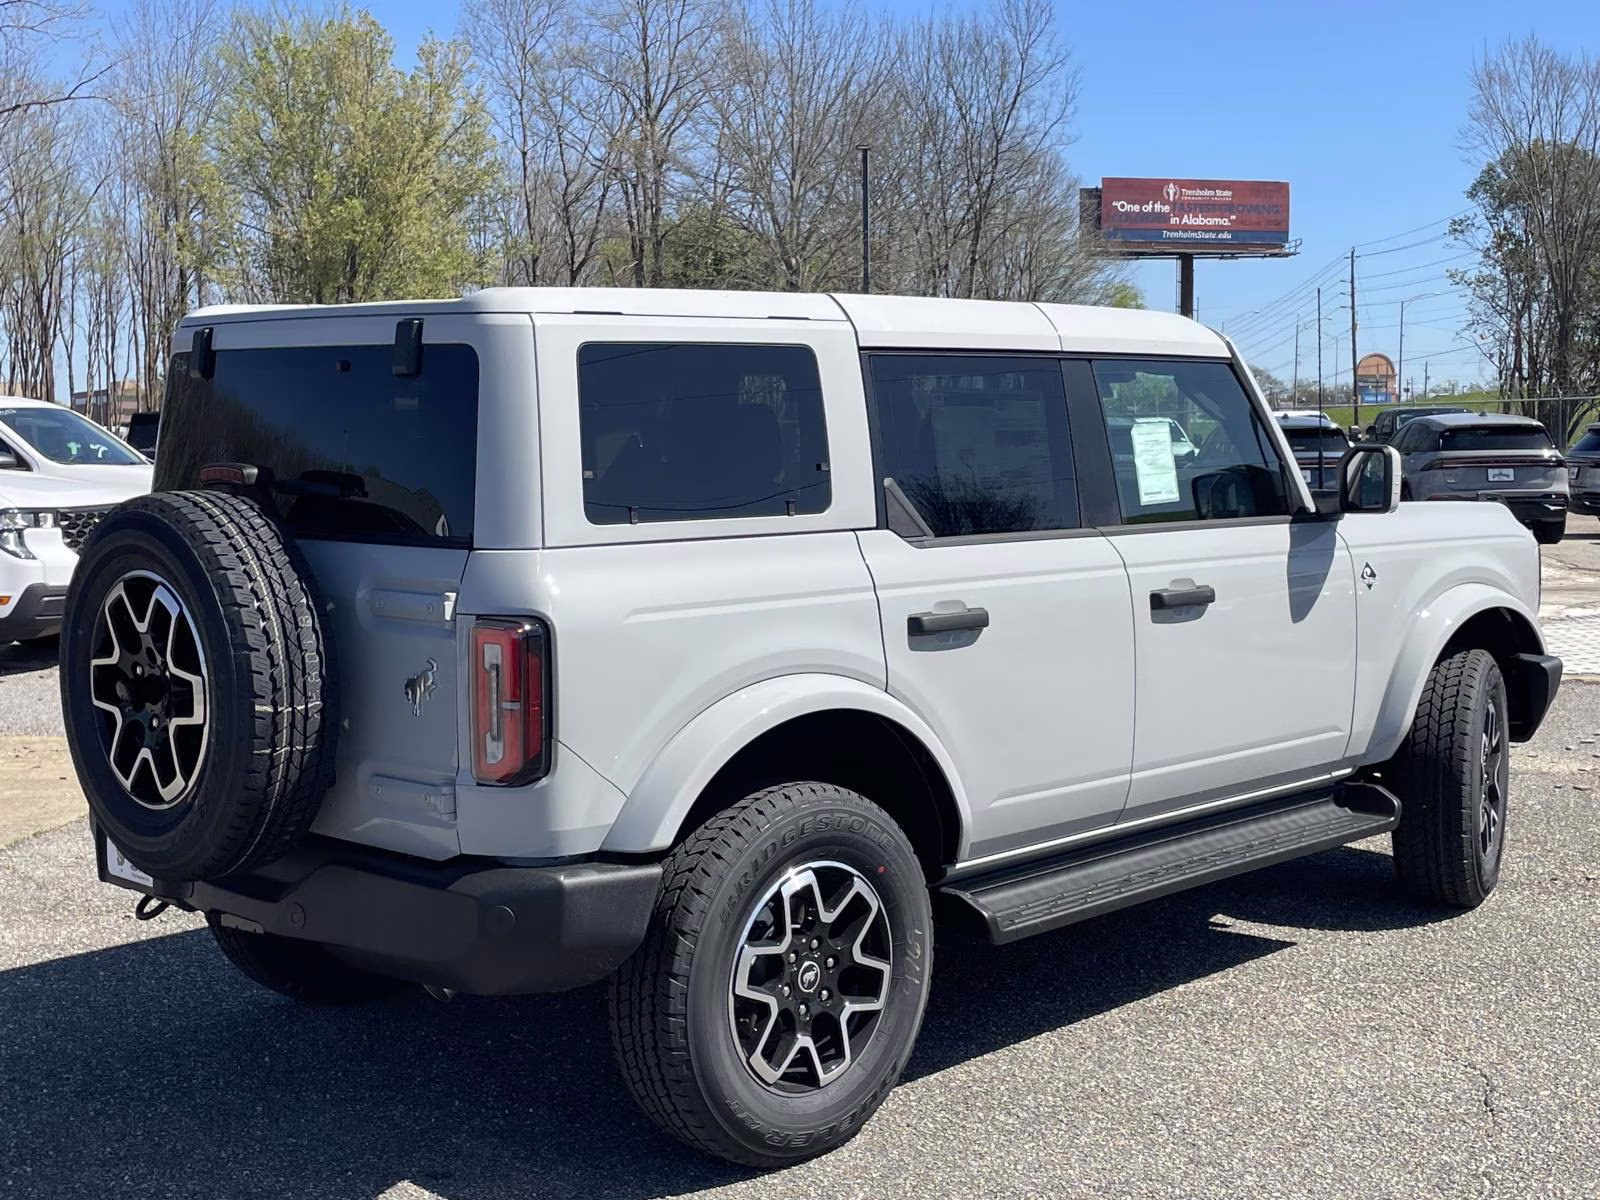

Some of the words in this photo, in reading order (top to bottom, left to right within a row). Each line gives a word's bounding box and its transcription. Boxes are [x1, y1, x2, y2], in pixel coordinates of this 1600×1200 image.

[1181, 188, 1214, 197] Trenholm
[1215, 189, 1232, 197] State
[1112, 200, 1140, 212] “One
[1142, 201, 1153, 212] of
[1154, 201, 1170, 212] the
[1170, 213, 1179, 225] in
[1181, 213, 1236, 226] Alabama.”
[1162, 230, 1232, 239] TrenholmState.edu
[719, 812, 896, 922] BRIDGESTONE
